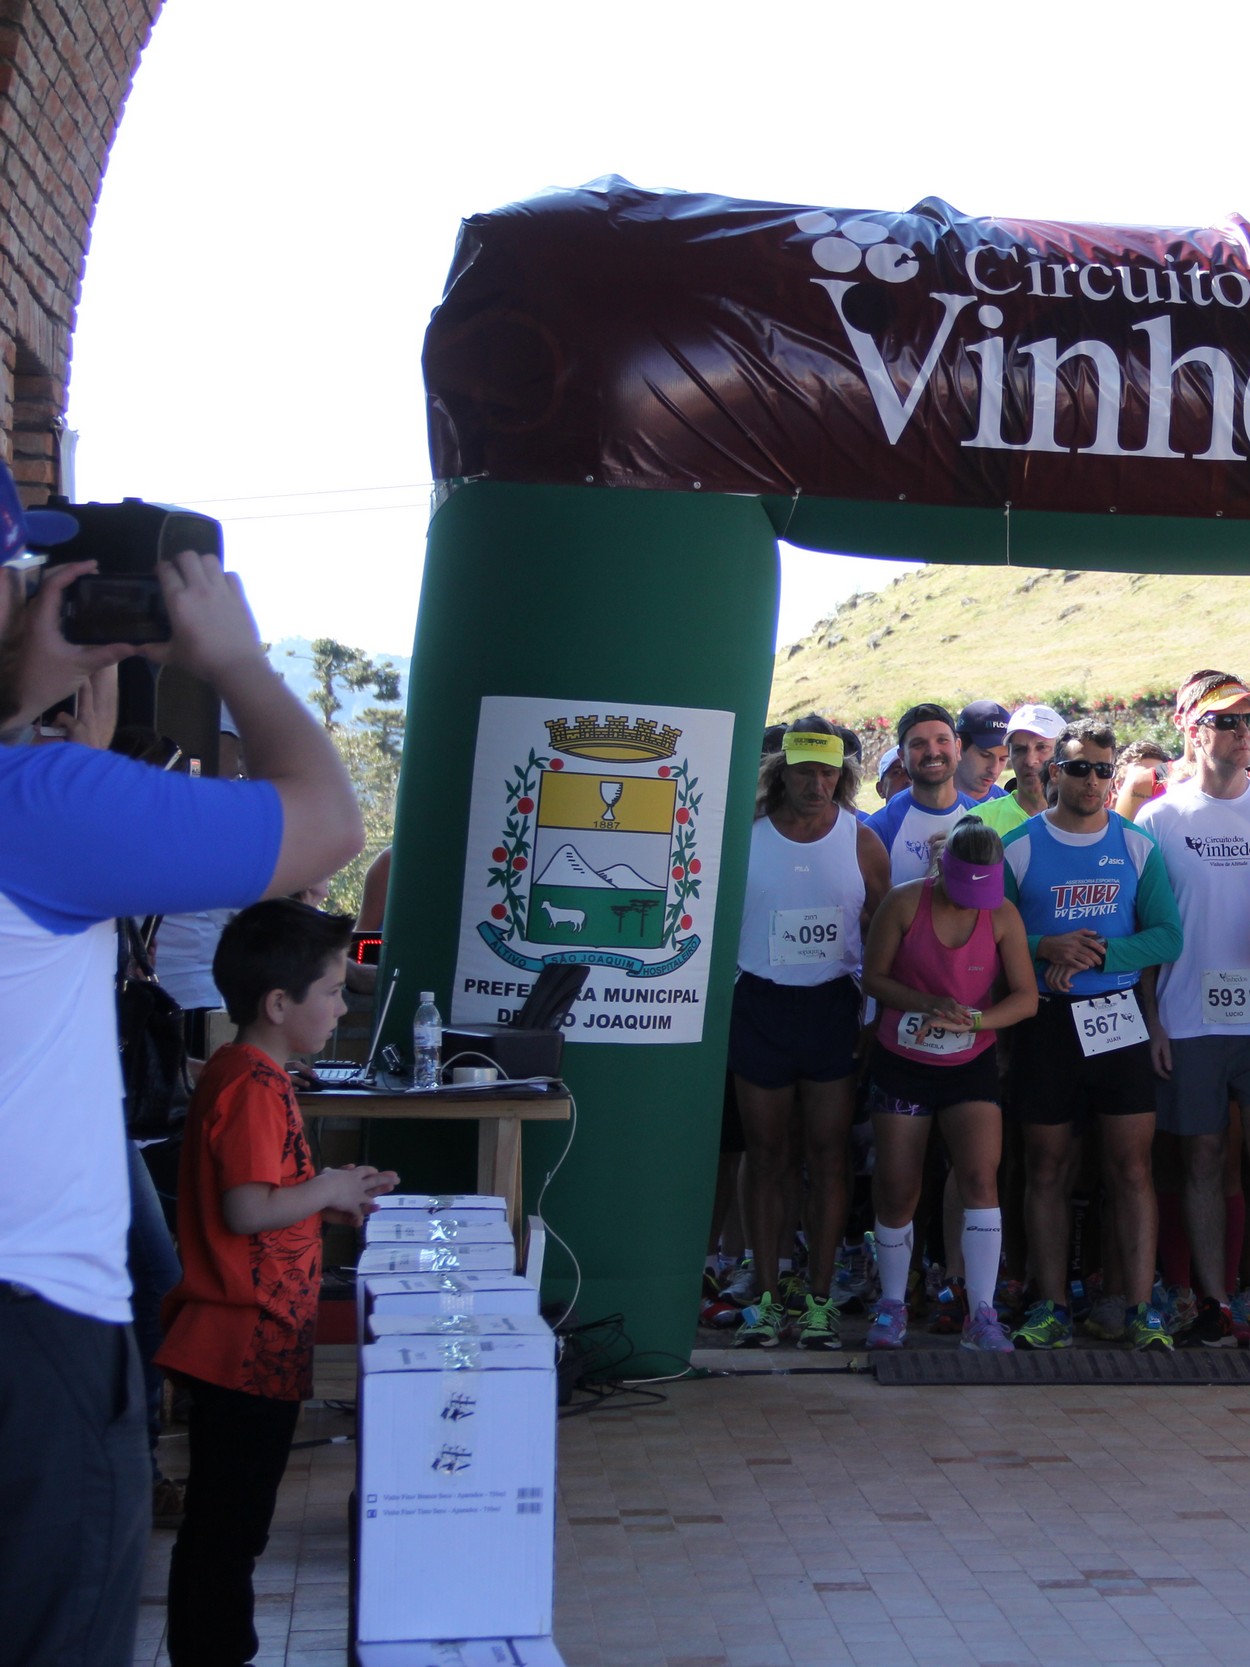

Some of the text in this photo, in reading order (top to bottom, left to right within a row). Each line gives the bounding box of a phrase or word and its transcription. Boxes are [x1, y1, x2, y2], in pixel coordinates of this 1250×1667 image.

[593, 821, 621, 830] 1887
[1205, 836, 1232, 844] Circuito
[1051, 883, 1120, 910] TRIBO
[1068, 903, 1118, 920] ESPORTE
[799, 924, 838, 944] 560
[490, 940, 527, 967] ALTIVO
[551, 954, 635, 969] SÃO JOAQUIM
[642, 940, 698, 976] HOSPITALEIRO
[464, 978, 700, 1004] PREFEA MUNICIPAL
[1208, 988, 1246, 1006] 593
[583, 1014, 672, 1030] JOAQUIM
[1084, 1012, 1118, 1037] 567
[1106, 1036, 1121, 1044] JUAN
